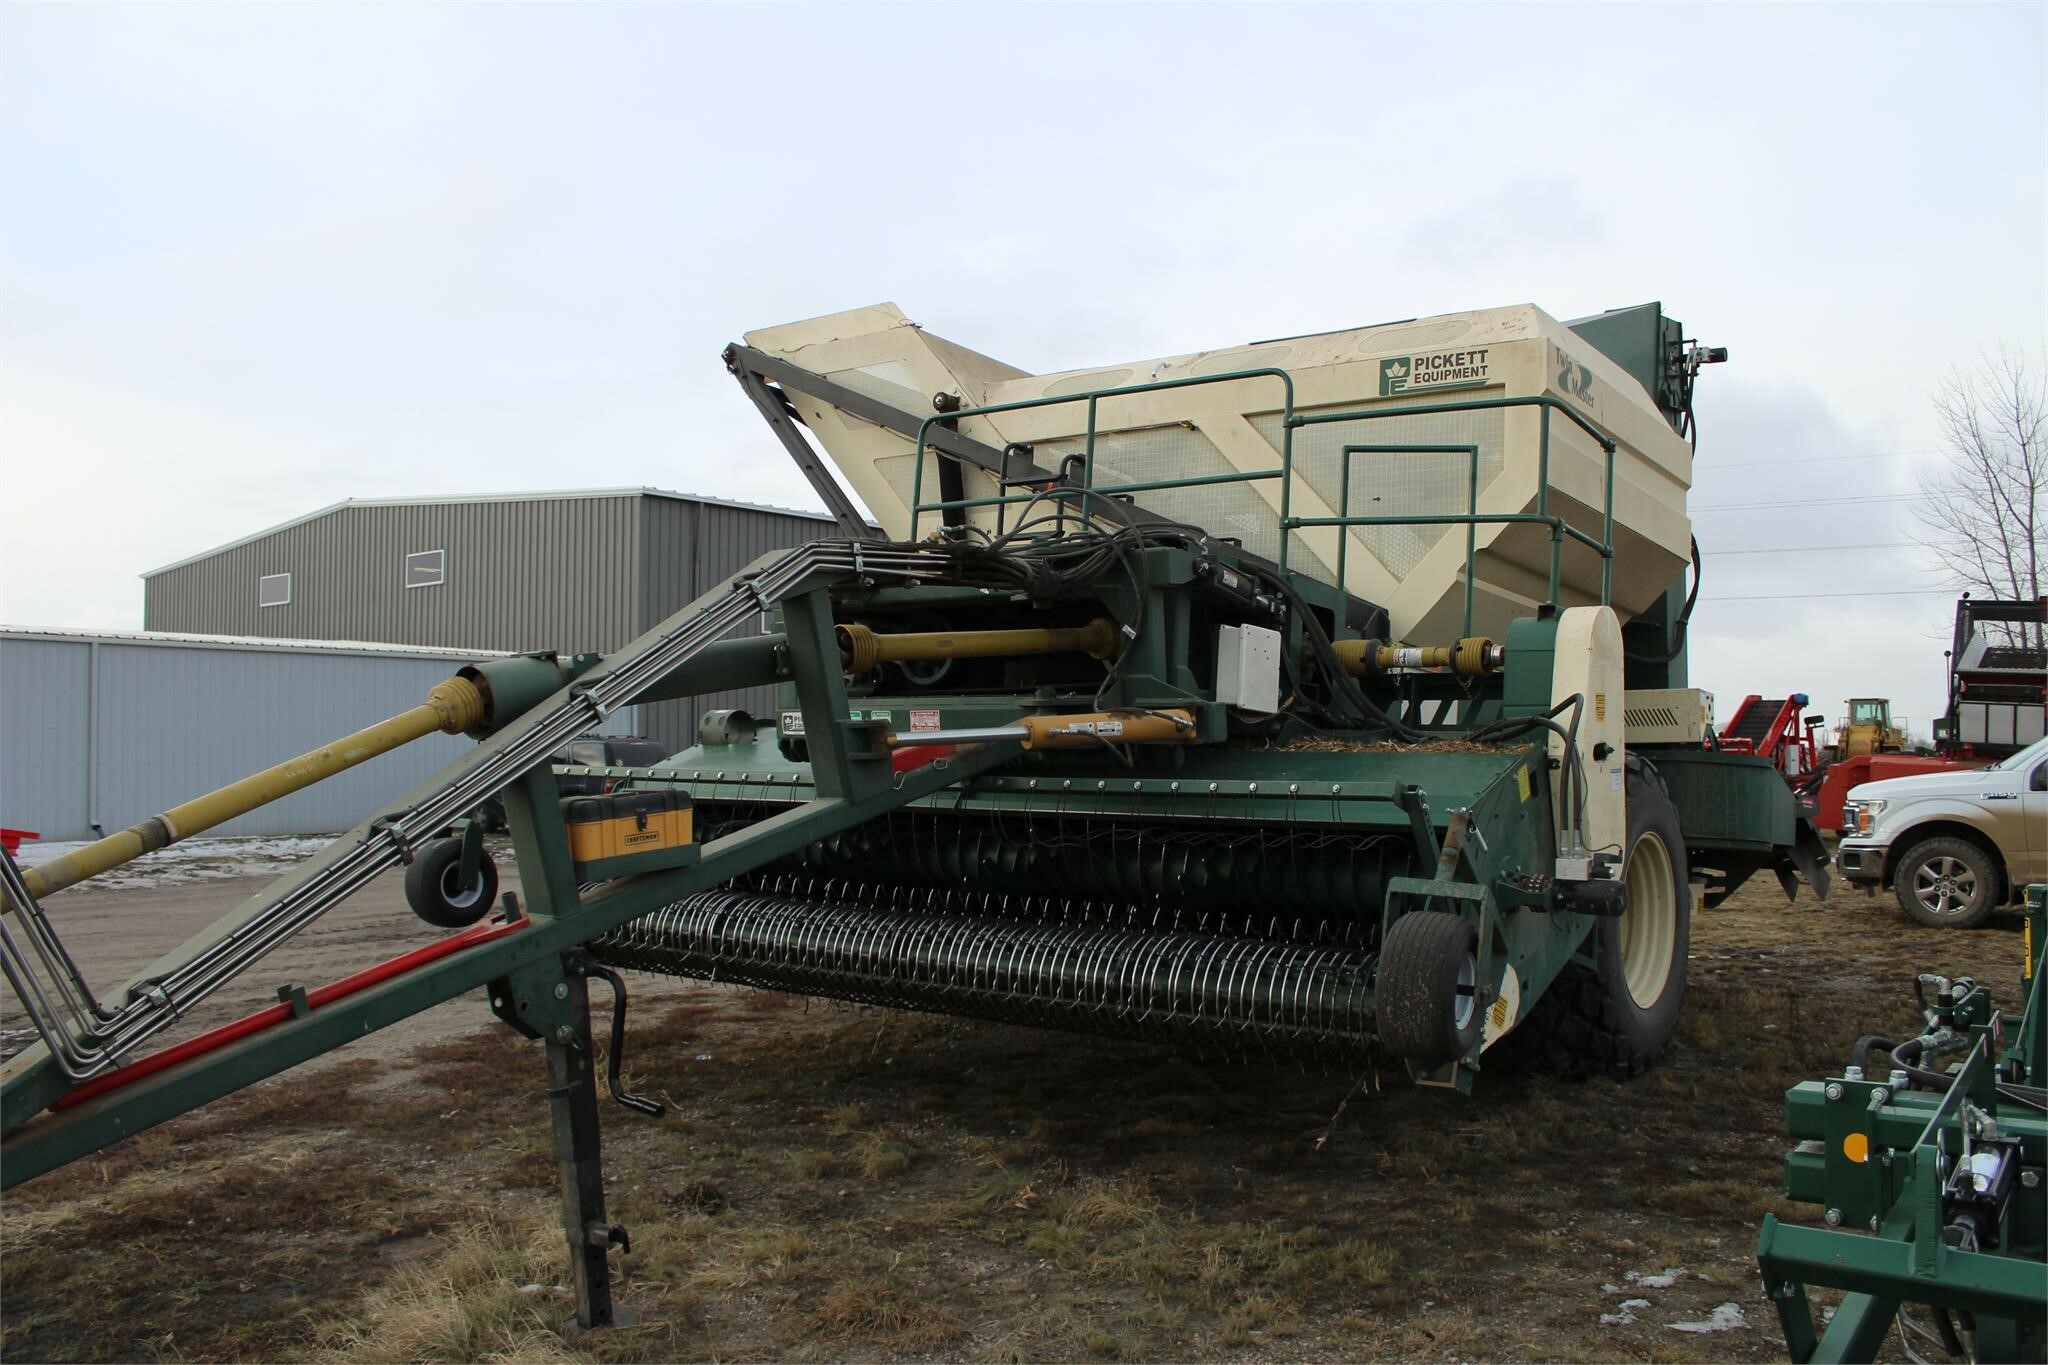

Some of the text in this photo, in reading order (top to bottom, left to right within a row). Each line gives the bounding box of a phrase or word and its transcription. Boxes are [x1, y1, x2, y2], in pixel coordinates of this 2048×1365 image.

[1414, 349, 1489, 371] PICKETT
[1556, 347, 1573, 374] Twin
[1414, 365, 1488, 384] EQUIPMENT
[1572, 377, 1594, 408] Master
